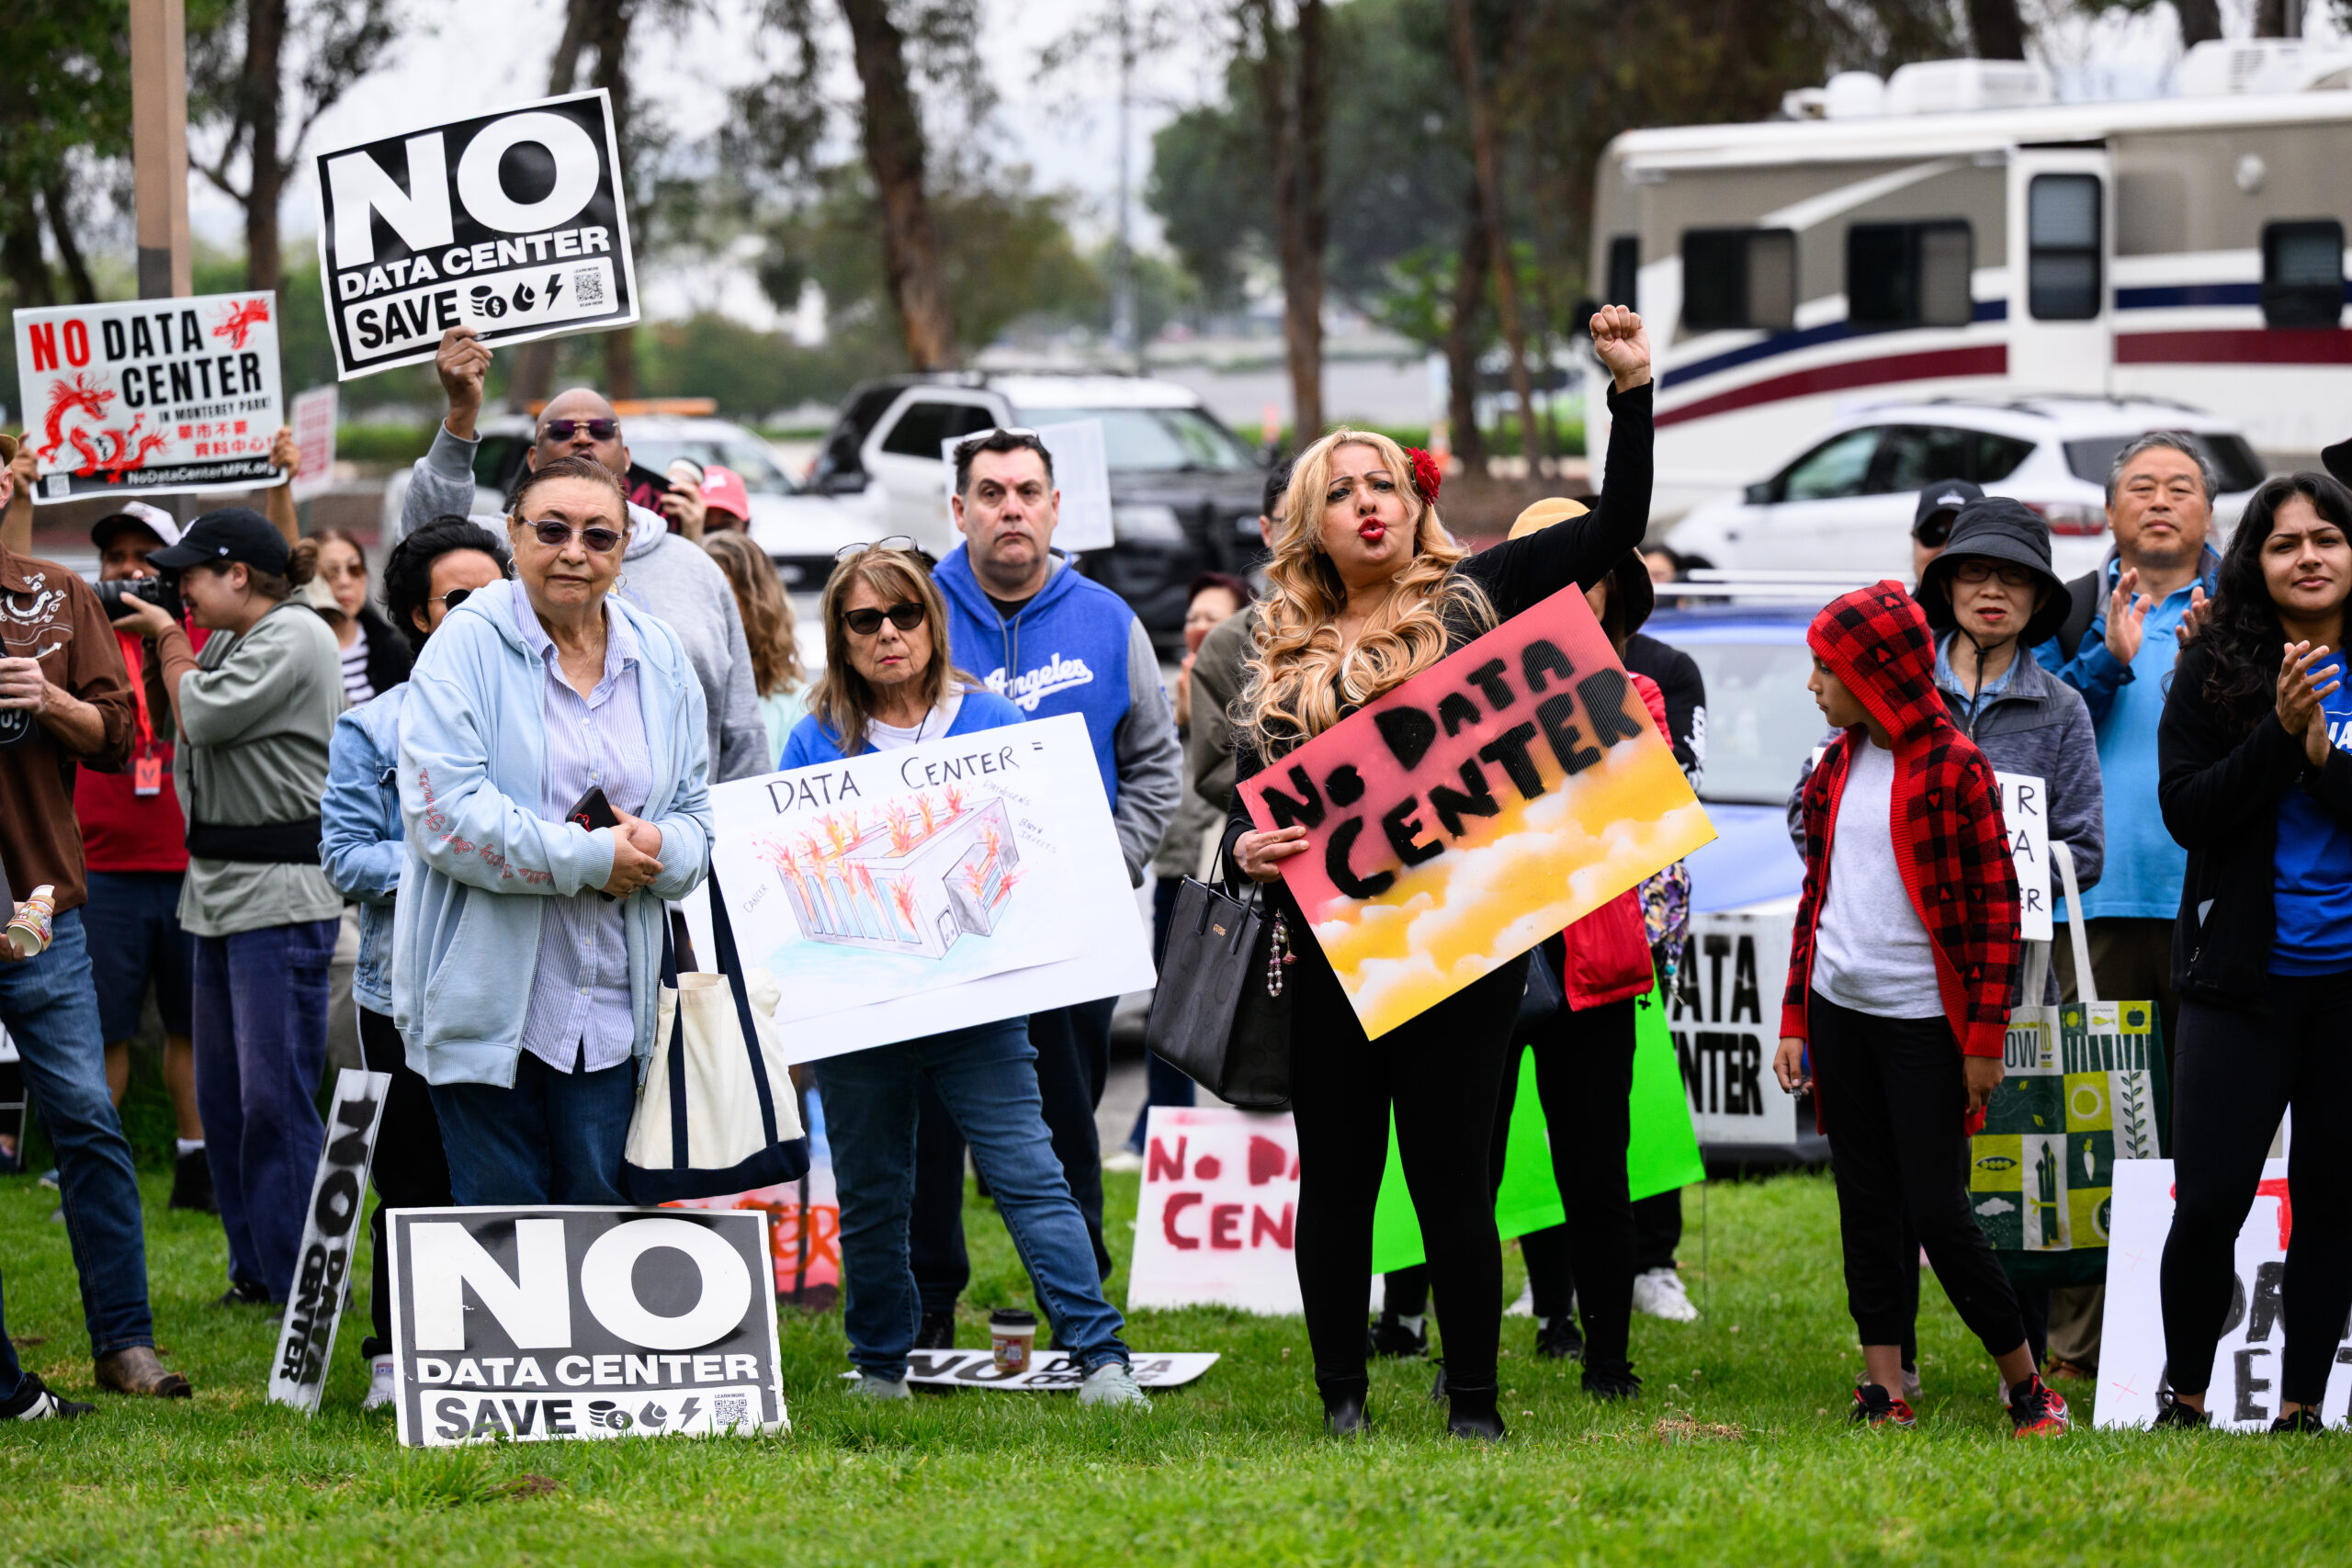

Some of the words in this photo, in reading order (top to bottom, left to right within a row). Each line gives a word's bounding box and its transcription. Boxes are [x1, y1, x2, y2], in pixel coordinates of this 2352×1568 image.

[327, 112, 600, 270] NO
[337, 255, 439, 301] DATA
[442, 226, 611, 276] CENTER
[28, 319, 90, 372] NO
[102, 310, 204, 362] DATA
[356, 288, 461, 349] SAVE
[121, 352, 262, 408] CENTER
[159, 410, 171, 423] IN
[175, 402, 234, 421] MONTEREY
[240, 396, 272, 412] PARK!
[127, 461, 277, 485] NoDataCenterMPK.org
[984, 652, 1093, 712] Angeles
[1374, 639, 1577, 772] DATA
[764, 771, 862, 815] DATA
[900, 746, 1020, 790] CENTER
[1325, 667, 1643, 900] CENTER
[1662, 933, 1762, 1024] ATA
[1670, 1031, 1763, 1116] NTER
[314, 1097, 379, 1238] NO
[1162, 1190, 1295, 1251] CEN
[279, 1244, 326, 1383] CENTER
[300, 1248, 347, 1385] DATA
[410, 1218, 752, 1352] NO
[416, 1357, 548, 1386] DATA
[555, 1354, 759, 1385] CENTER
[435, 1397, 577, 1440] SAVE
